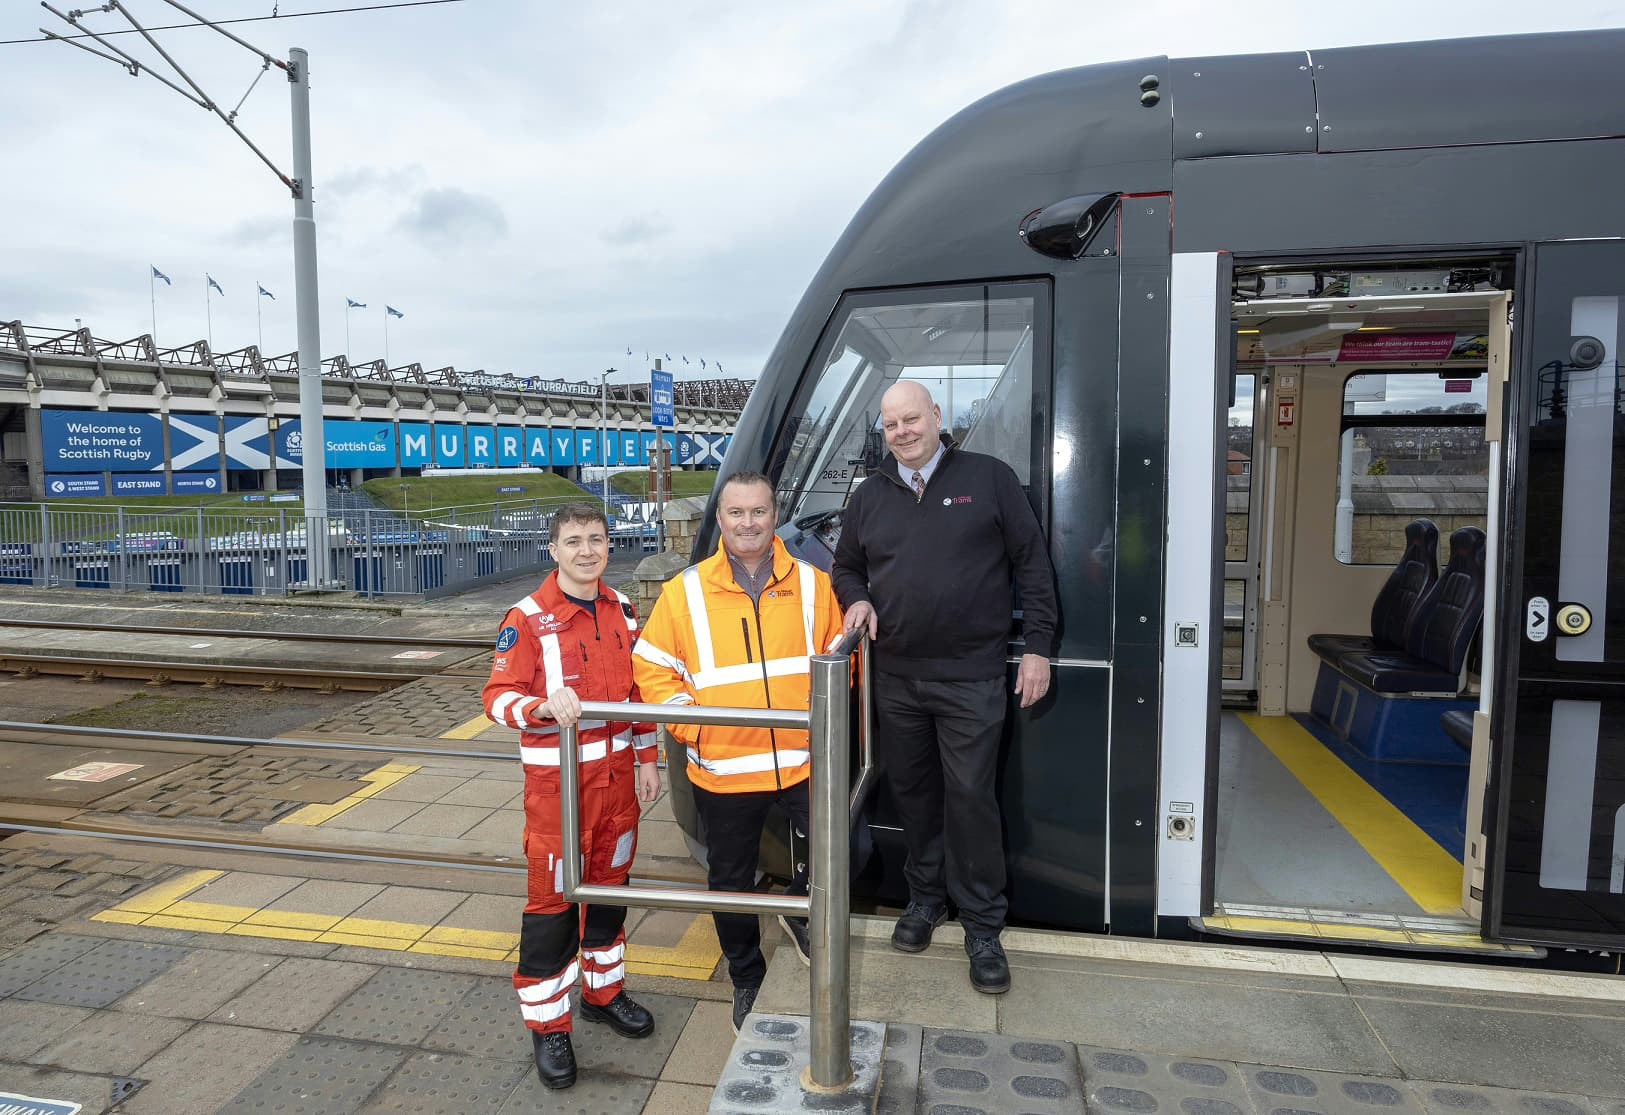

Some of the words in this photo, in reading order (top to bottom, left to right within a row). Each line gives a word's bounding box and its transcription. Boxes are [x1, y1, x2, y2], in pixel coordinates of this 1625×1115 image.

[533, 382, 599, 396] MURRAYFIELD
[66, 422, 126, 434] Welcome
[128, 424, 141, 434] to
[67, 436, 90, 446] the
[92, 437, 127, 447] home
[129, 437, 142, 447] of
[326, 441, 367, 452] Scottish
[368, 442, 386, 452] Gas
[58, 448, 111, 459] Scottish
[113, 449, 151, 461] Rugby
[822, 469, 849, 480] 262-E
[117, 481, 136, 489] EAST
[136, 480, 161, 488] STAND
